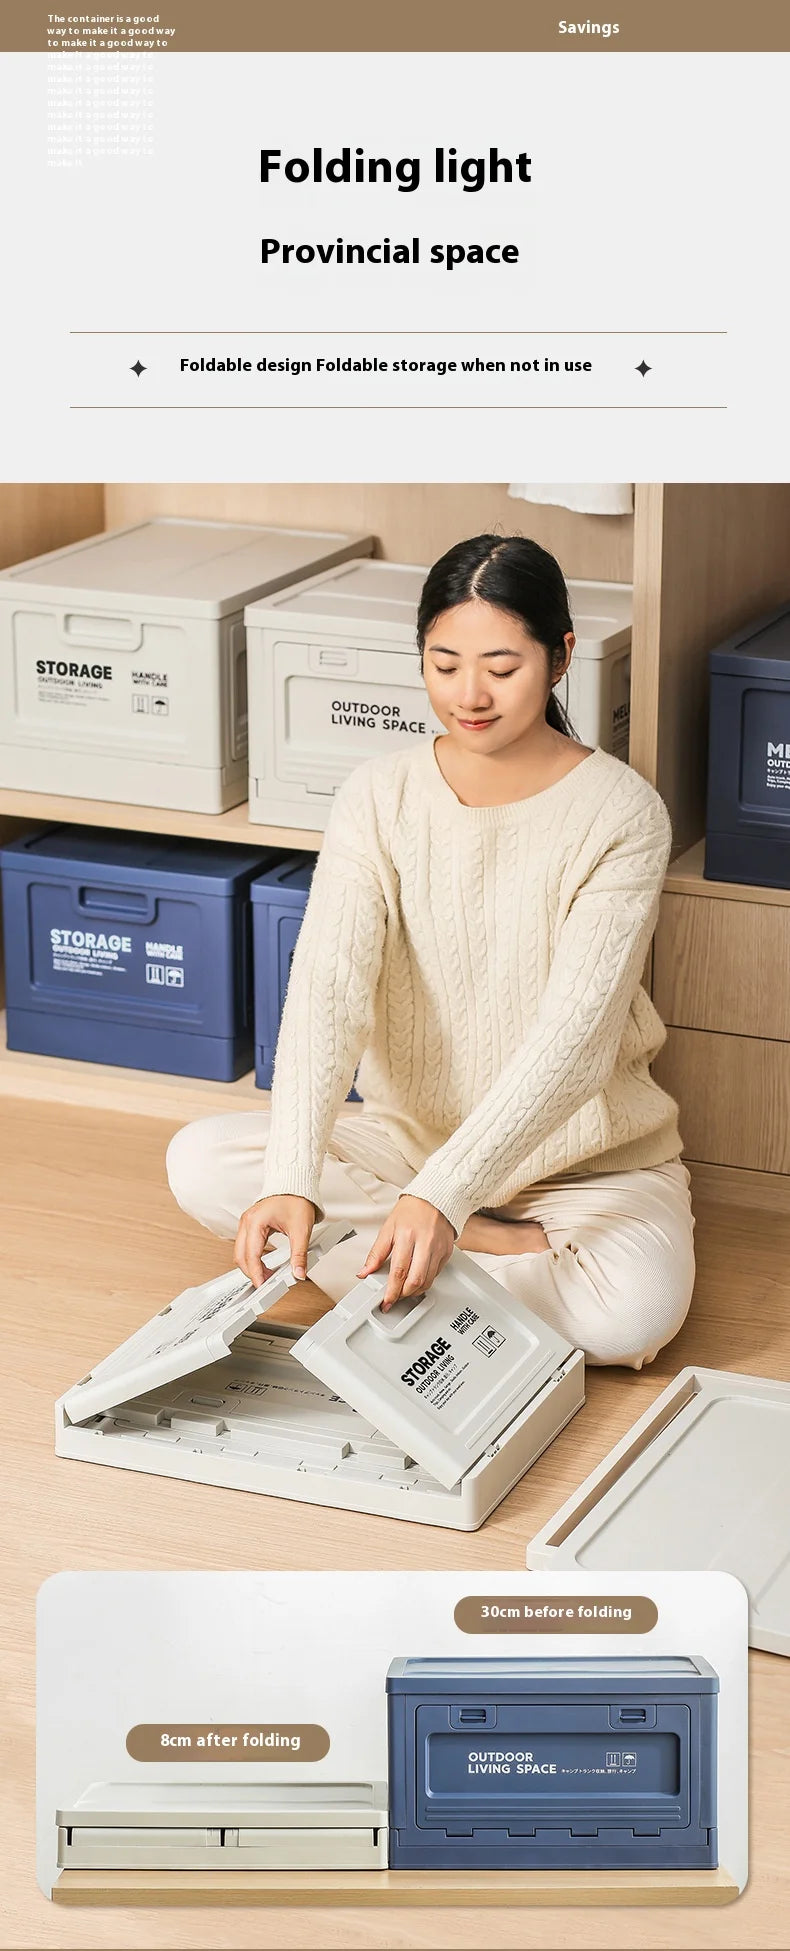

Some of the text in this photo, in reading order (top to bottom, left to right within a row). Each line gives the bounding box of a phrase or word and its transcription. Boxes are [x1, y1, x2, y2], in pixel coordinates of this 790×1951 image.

[36, 660, 112, 680] STORAGE
[331, 700, 400, 717] OUTDOOR
[331, 714, 426, 734] LIVING SPACE
[50, 928, 132, 953] STORAGE
[450, 1307, 474, 1331] HANDLE
[458, 1312, 480, 1335] WITH CARE
[400, 1336, 452, 1387] STORAGE
[416, 1369, 439, 1393] OUTDOOR
[437, 1354, 454, 1371] LIVING
[468, 1752, 534, 1763] OUTDOOR
[468, 1763, 557, 1774] LIVING SPACE
